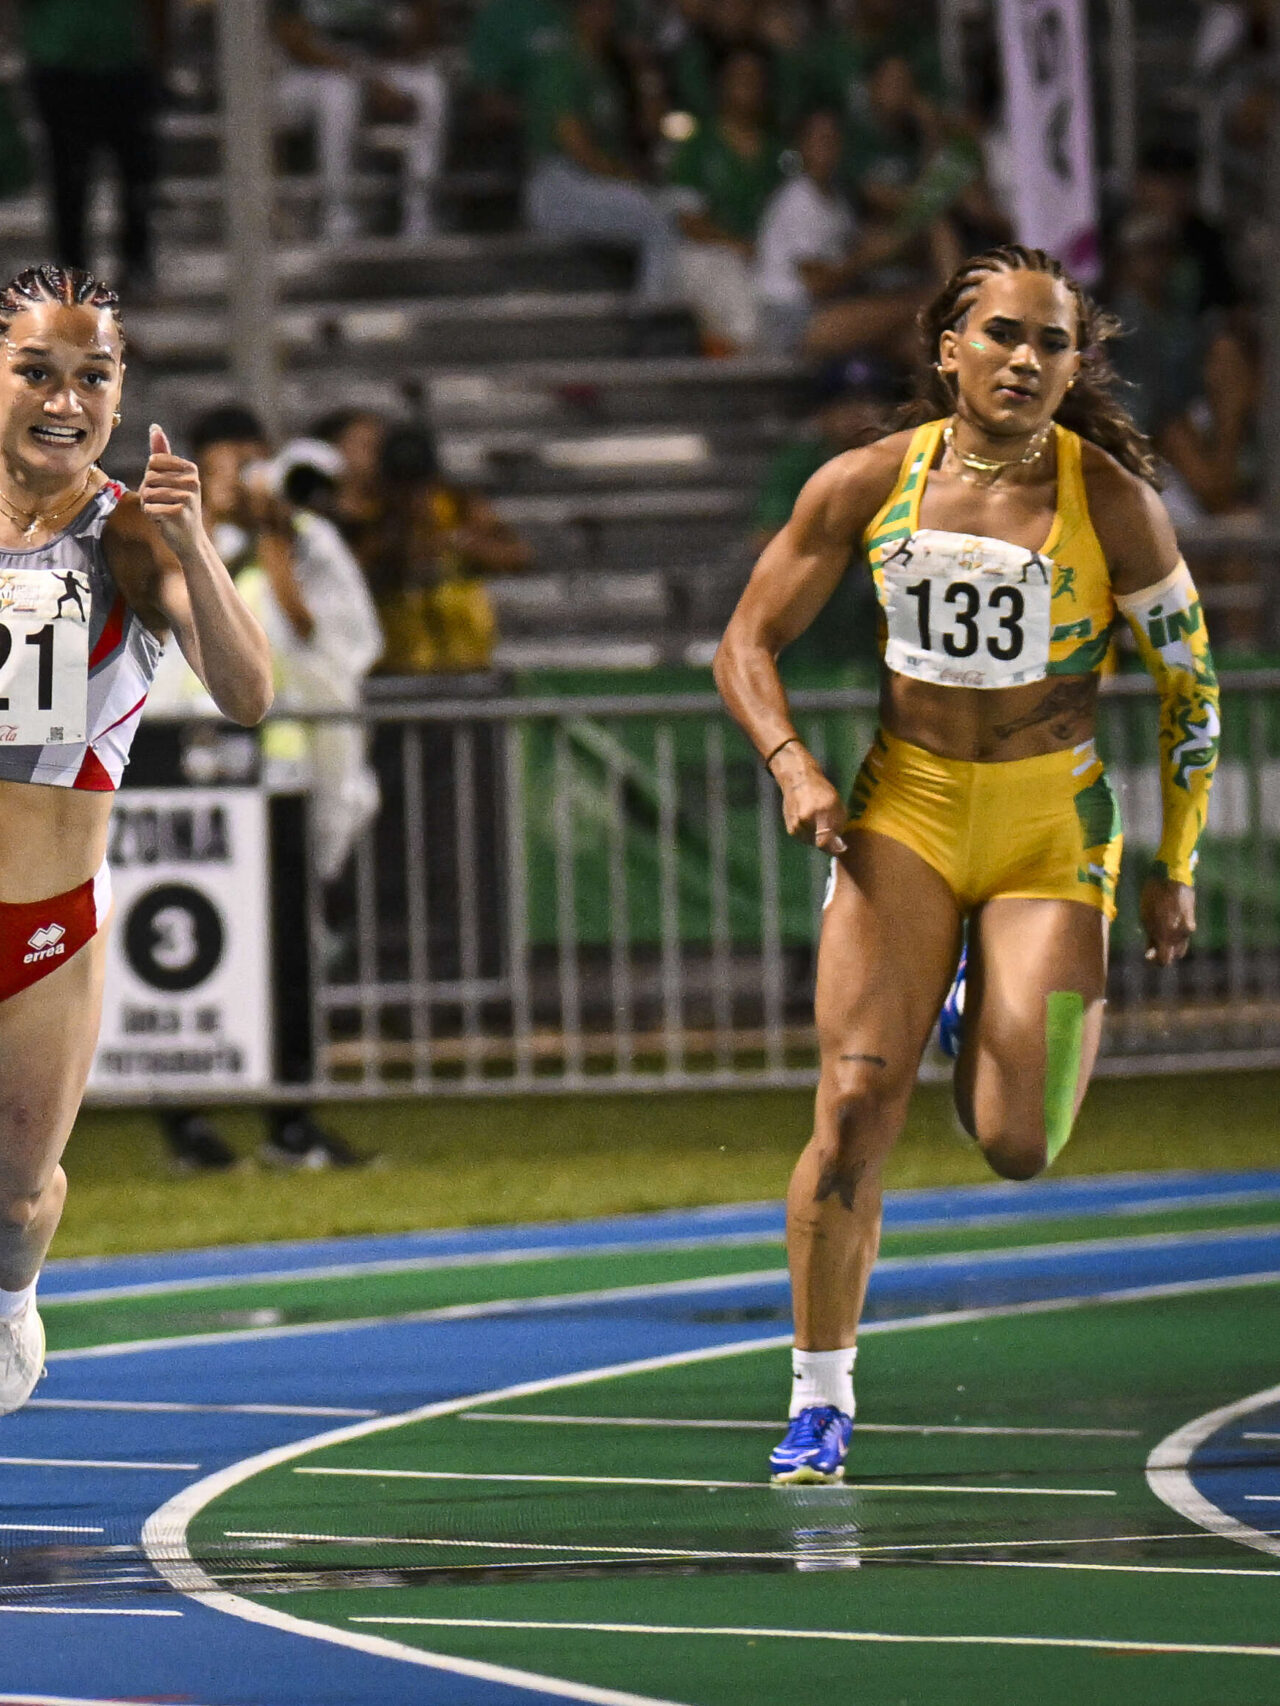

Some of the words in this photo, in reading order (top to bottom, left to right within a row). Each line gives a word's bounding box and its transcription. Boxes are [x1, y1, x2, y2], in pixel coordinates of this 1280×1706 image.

[906, 579, 1024, 661] 133
[108, 806, 233, 868] ZONA
[150, 905, 197, 971] 3
